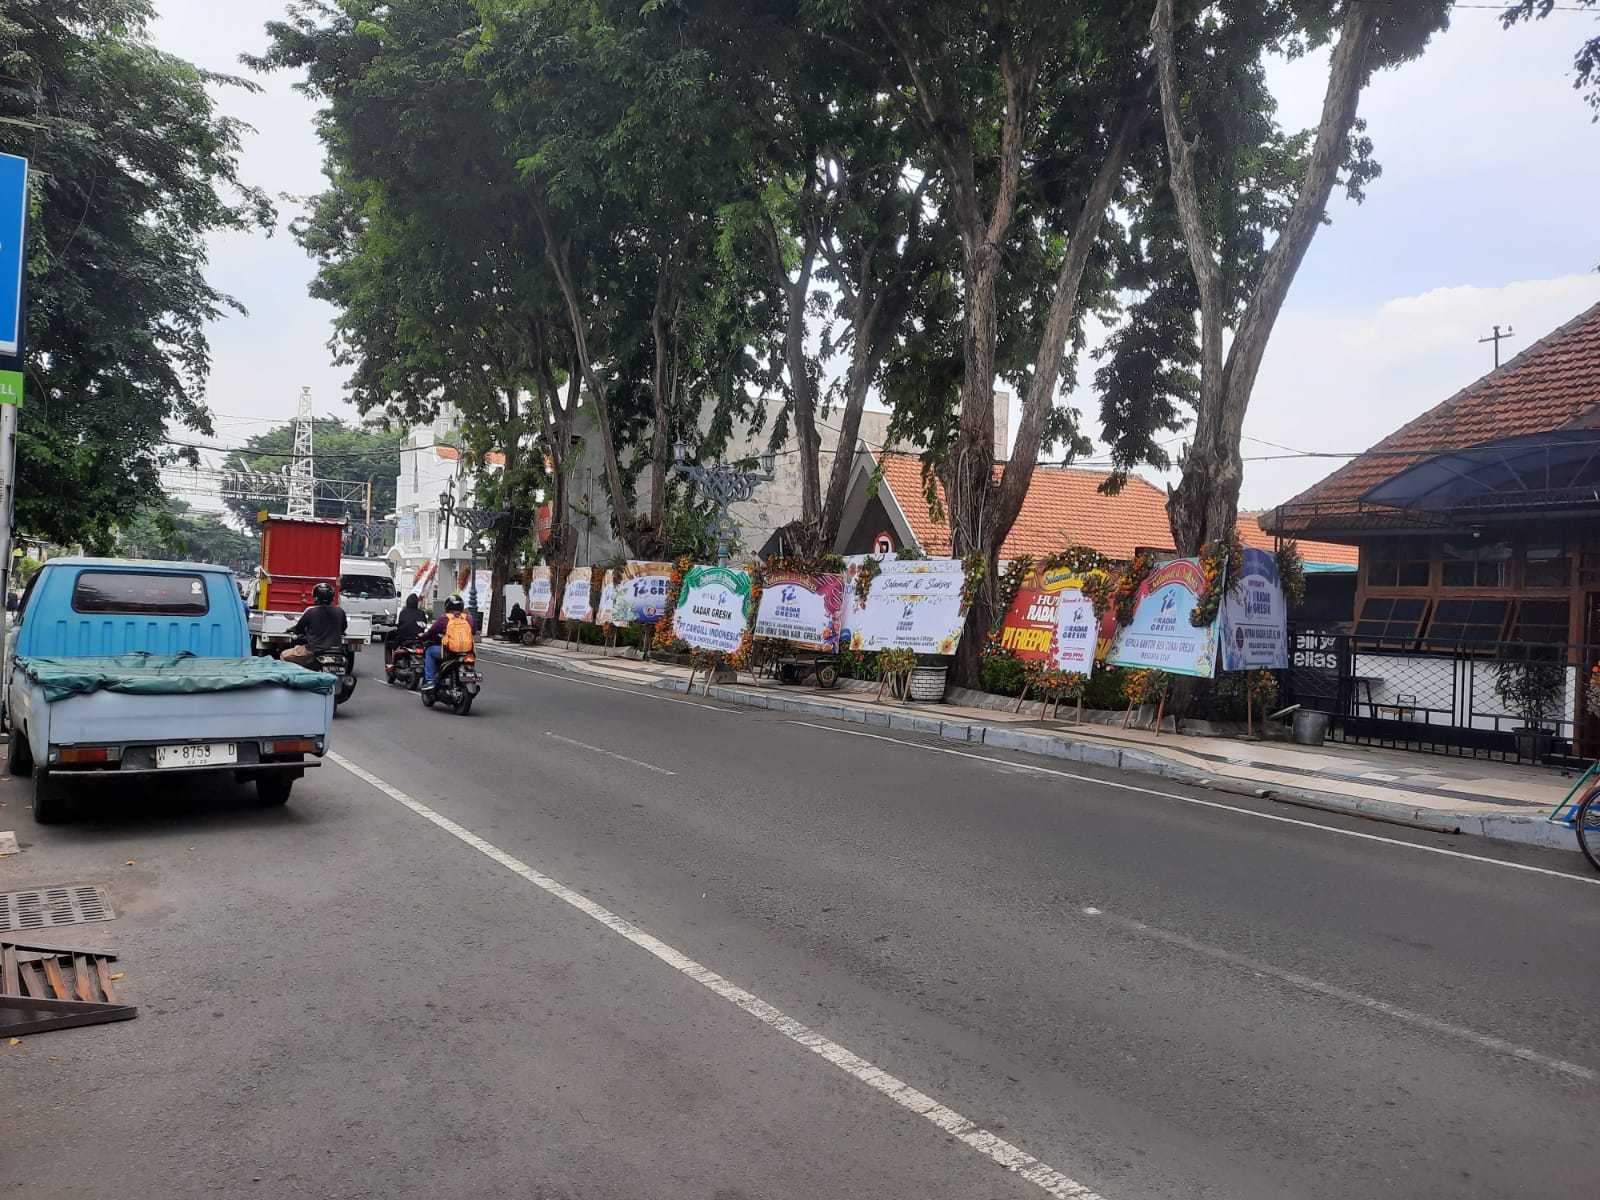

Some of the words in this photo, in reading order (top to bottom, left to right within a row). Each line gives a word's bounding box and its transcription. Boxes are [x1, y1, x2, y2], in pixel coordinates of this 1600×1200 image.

[882, 578, 912, 590] Selamat
[925, 579, 953, 590] Sukses
[1037, 595, 1060, 605] HUT
[693, 605, 710, 617] RADAR
[711, 608, 733, 620] GRESIK
[775, 610, 800, 618] GRESIK
[781, 606, 801, 614] RADAR
[1027, 605, 1059, 624] RADA
[1253, 603, 1271, 615] GRESIK
[679, 622, 686, 630] PT
[686, 623, 708, 636] CARGILL
[709, 627, 739, 642] INDONESIA
[1150, 624, 1175, 632] GRESIK
[1001, 627, 1016, 650] PT
[1015, 628, 1053, 653] FREEPO
[1288, 651, 1337, 669] ellas
[157, 747, 166, 761] W
[228, 743, 235, 756] D
